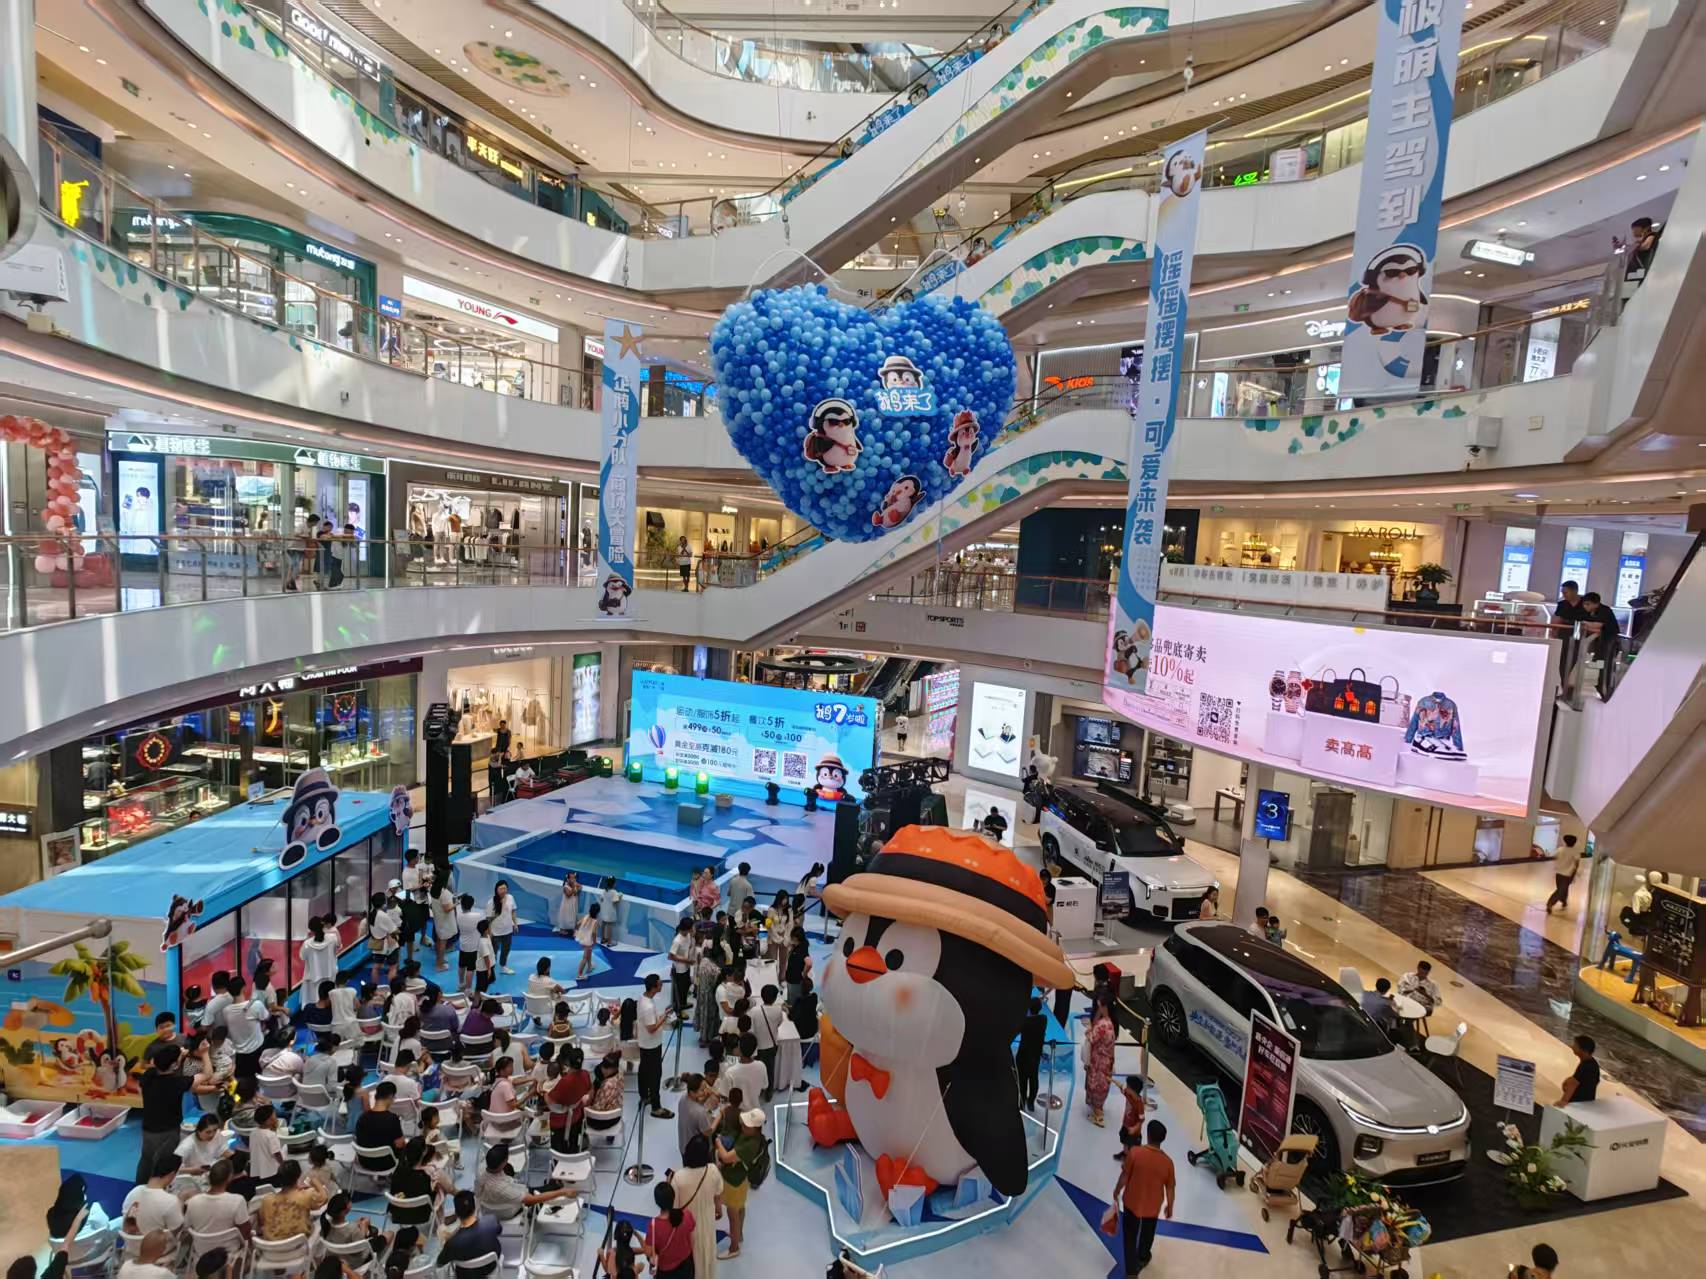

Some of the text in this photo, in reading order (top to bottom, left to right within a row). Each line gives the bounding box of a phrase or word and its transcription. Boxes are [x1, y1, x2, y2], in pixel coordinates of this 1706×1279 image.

[458, 298, 492, 319] YOUNG
[875, 389, 931, 411] 鹅来了
[1150, 637, 1207, 663] 品兜底寄卖
[1325, 738, 1373, 761] 卖高高
